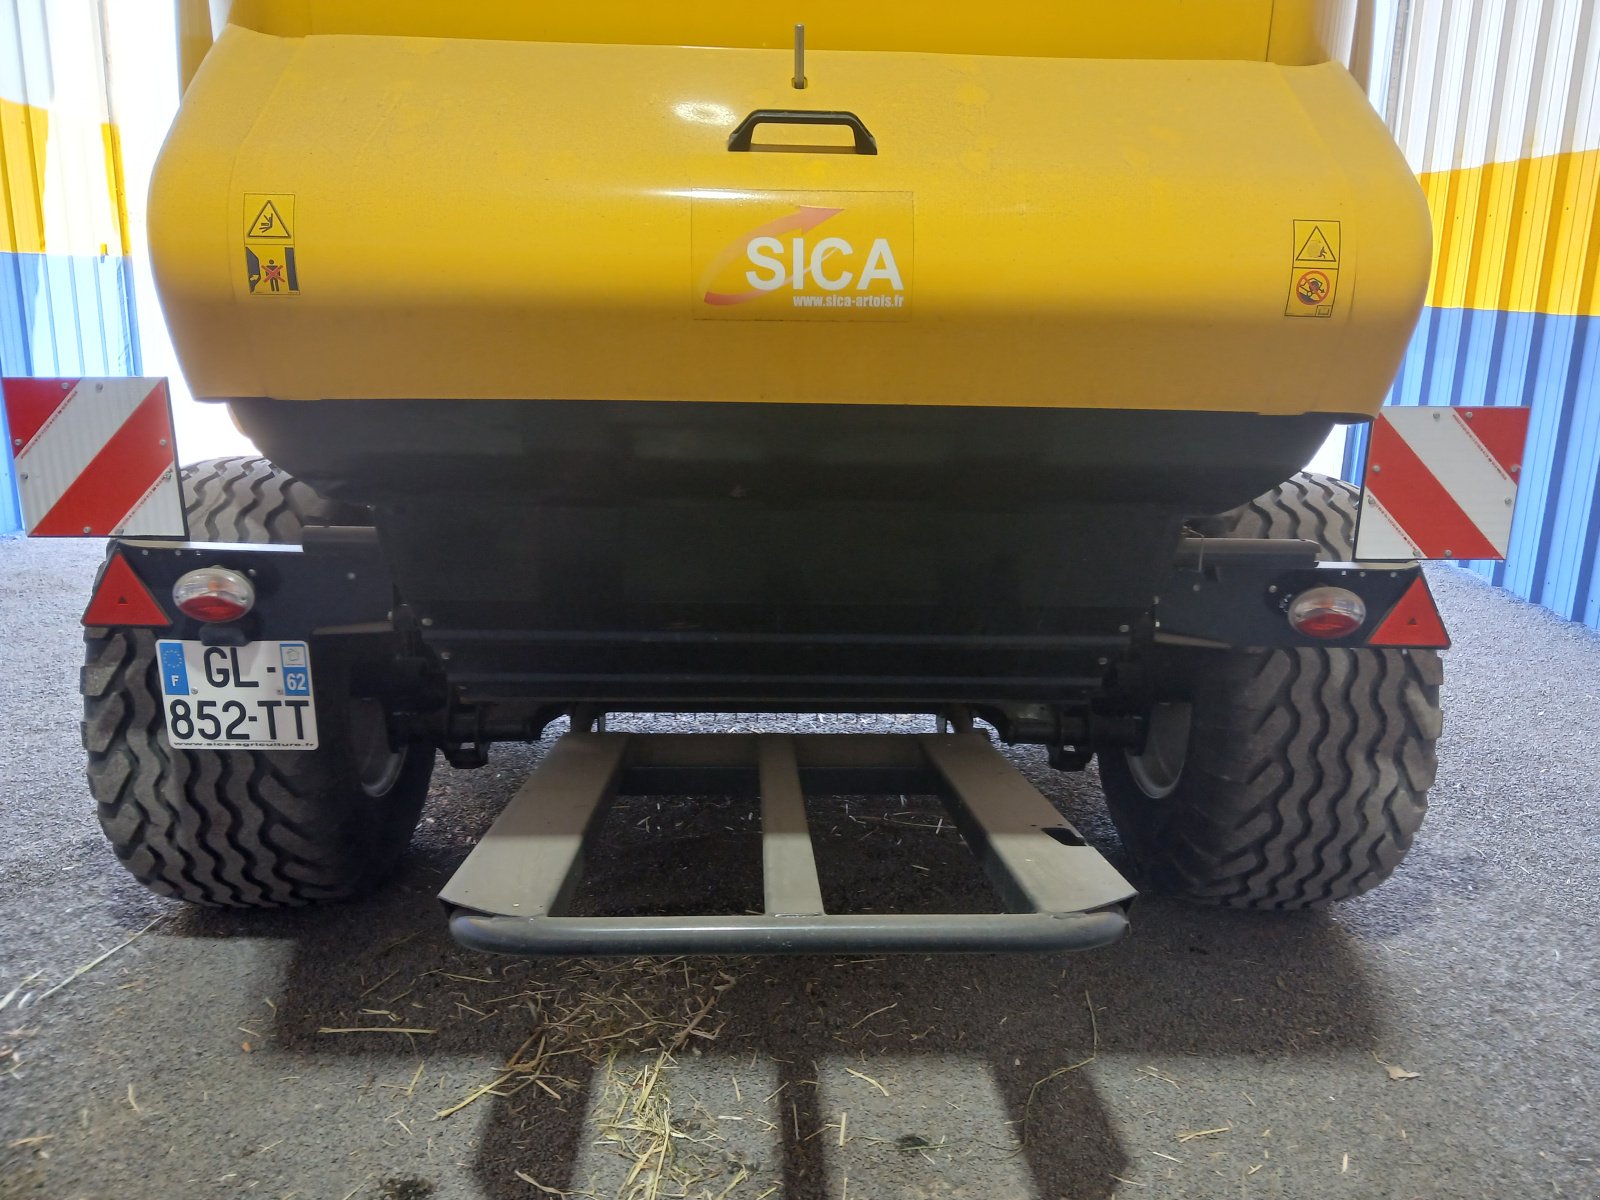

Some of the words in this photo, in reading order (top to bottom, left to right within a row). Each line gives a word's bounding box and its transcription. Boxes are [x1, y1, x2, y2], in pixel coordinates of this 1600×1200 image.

[745, 236, 904, 291] SICA
[793, 294, 904, 308] www.sica-artois.fr
[171, 675, 179, 687] F
[286, 673, 307, 691] 62
[169, 698, 310, 740] 852-TT
